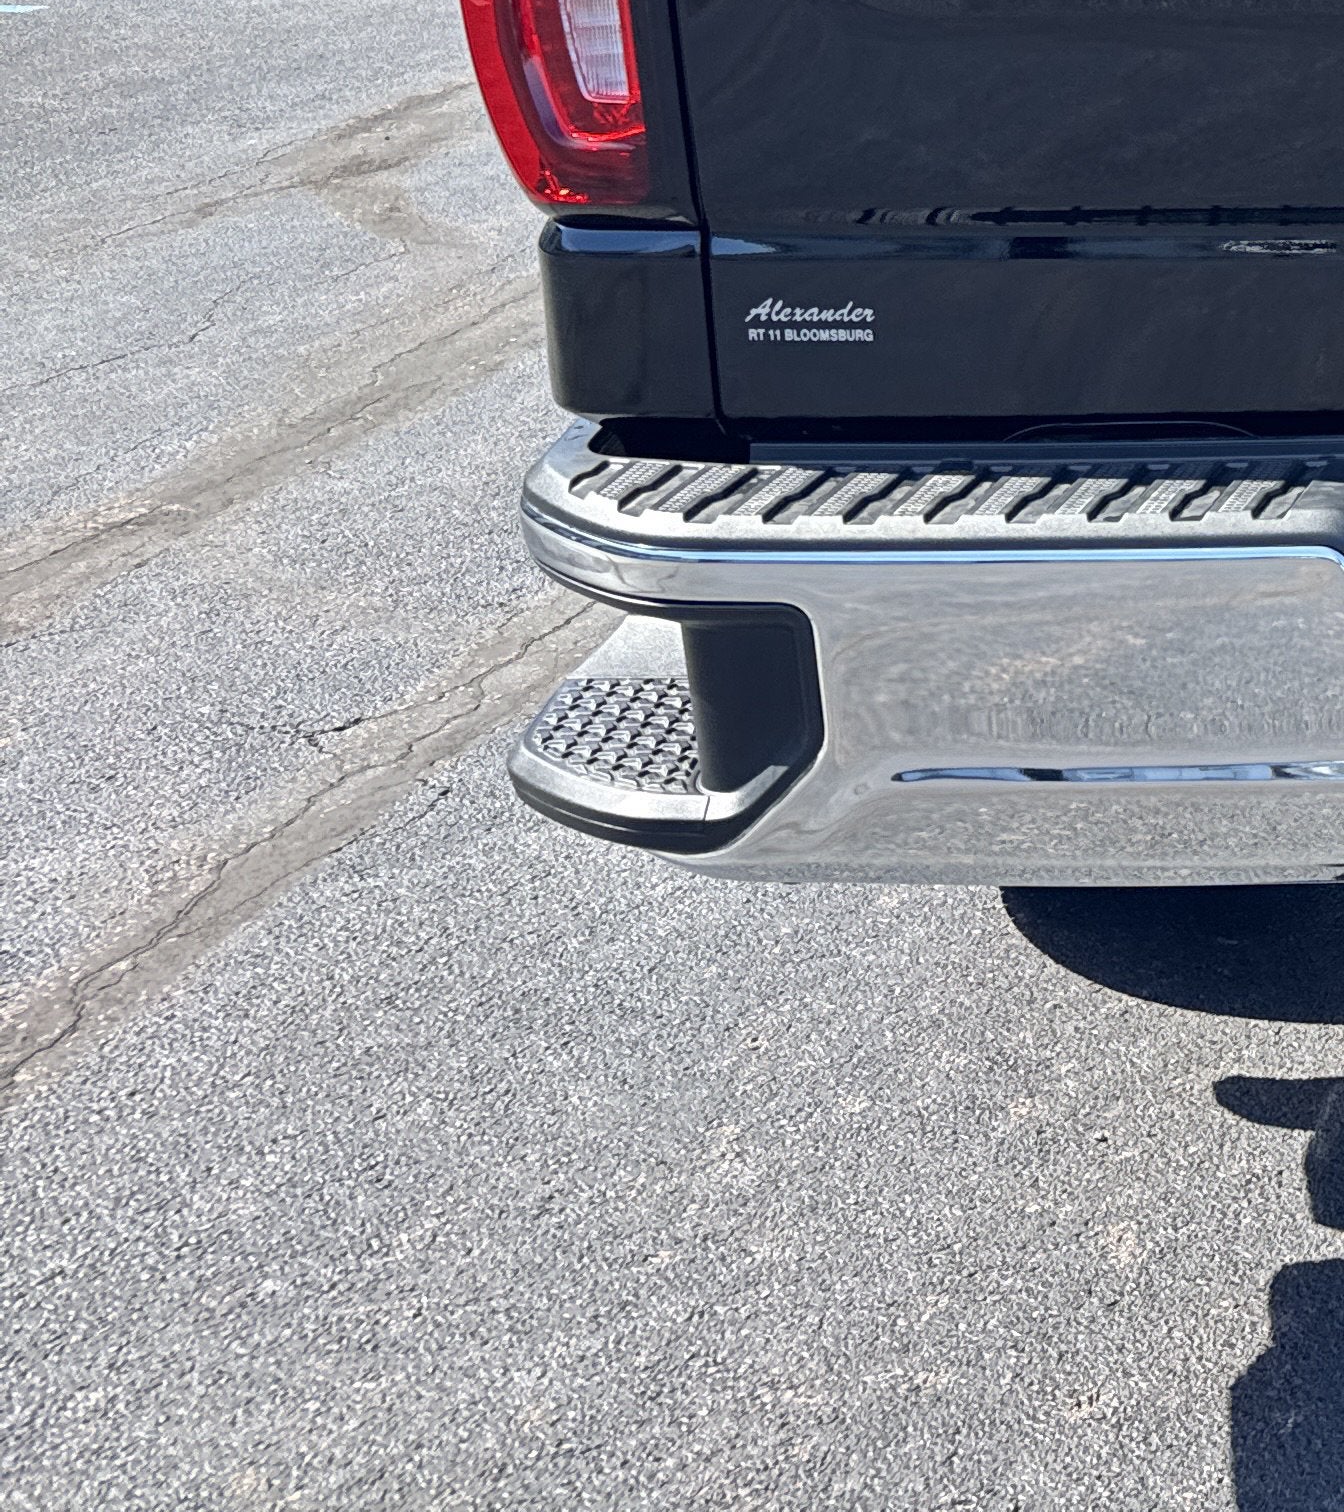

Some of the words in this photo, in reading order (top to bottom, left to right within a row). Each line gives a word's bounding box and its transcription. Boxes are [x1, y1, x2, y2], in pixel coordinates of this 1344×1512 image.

[744, 297, 876, 323] Alexander
[748, 329, 765, 341] RT
[768, 329, 780, 341] 11
[784, 329, 874, 341] BLOOMSBURG
